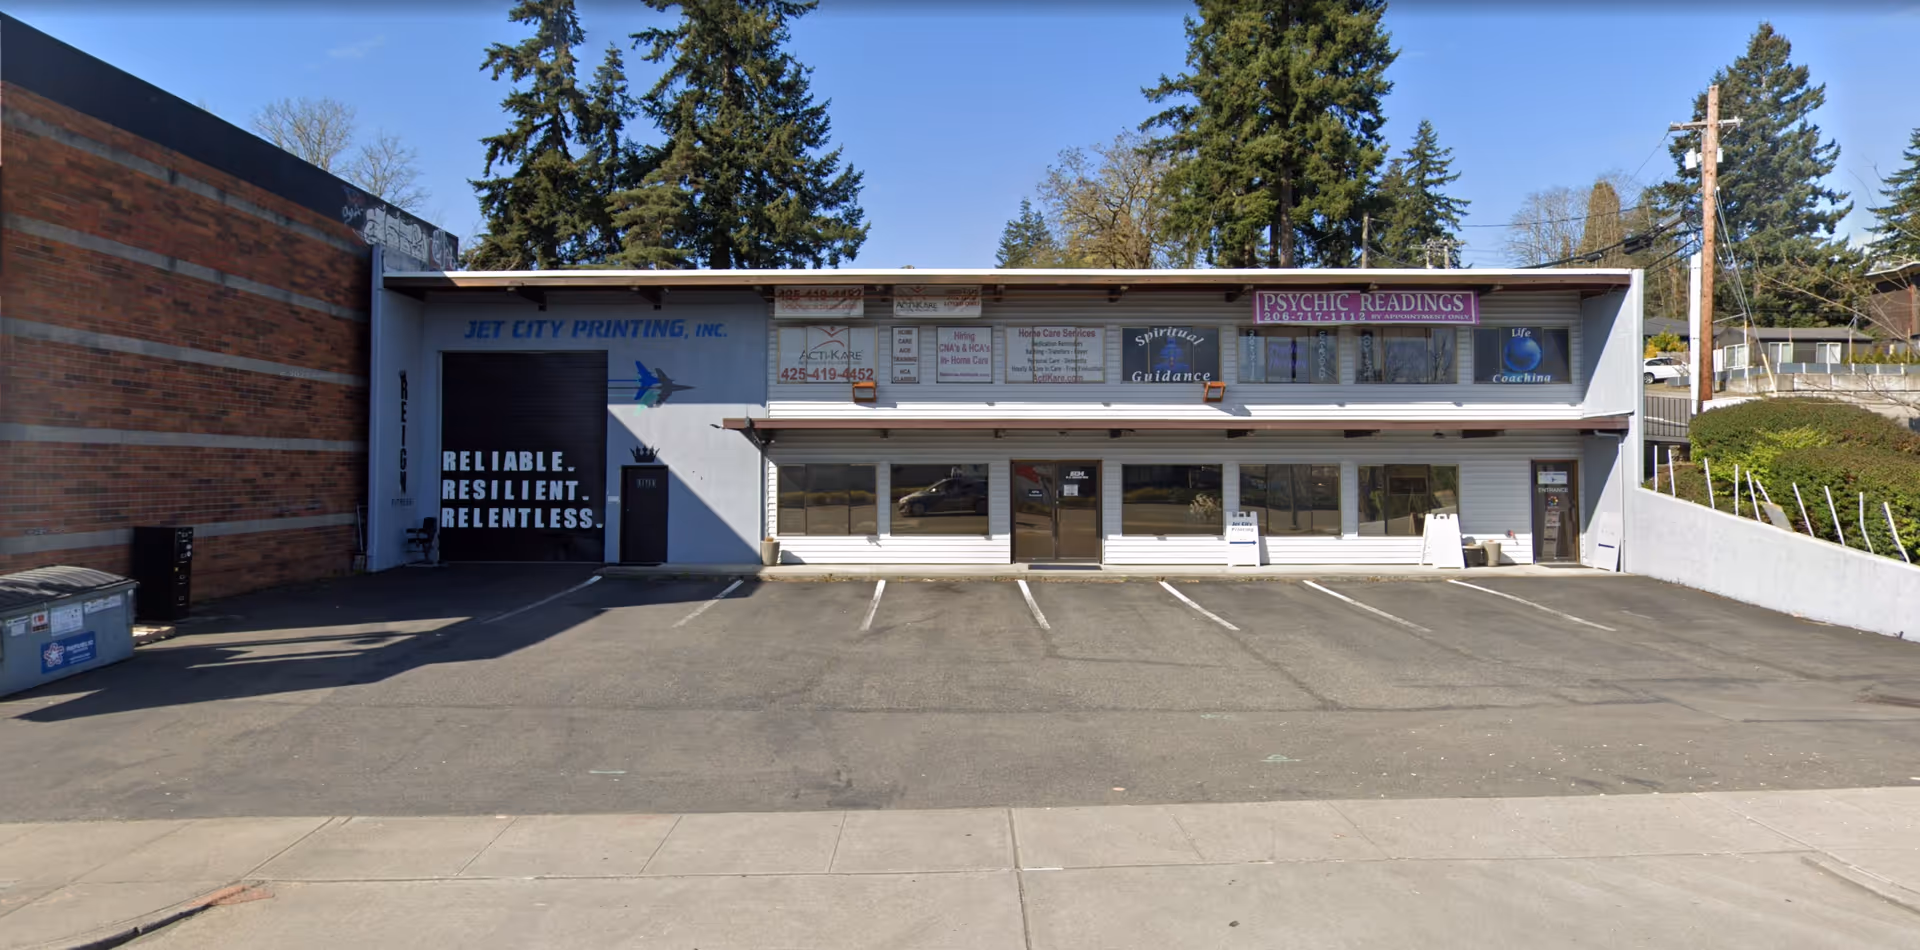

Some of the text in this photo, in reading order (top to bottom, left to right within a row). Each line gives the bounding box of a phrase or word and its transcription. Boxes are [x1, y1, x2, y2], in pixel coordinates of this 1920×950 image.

[1263, 292, 1465, 312] PSYCHIC READINGS
[1263, 312, 1366, 321] 206-717-1112
[464, 319, 728, 340] JET CITY PRINTING, INC.
[1018, 328, 1096, 338] Home Care Services
[1511, 327, 1532, 338] Life
[953, 331, 976, 342] Hiring
[1135, 326, 1205, 347] Spiritual
[939, 344, 990, 353] CNA's & HCA's
[951, 356, 971, 365] Home
[972, 356, 988, 365] Care
[780, 367, 874, 381] 425-419-4452
[1131, 370, 1211, 383] Guidance
[1492, 372, 1552, 383] Coaching
[400, 376, 408, 494] REIGN
[442, 451, 576, 472] RELIABLE.
[442, 480, 590, 501] RESILIENT.
[441, 507, 604, 529] RELENTLESS.
